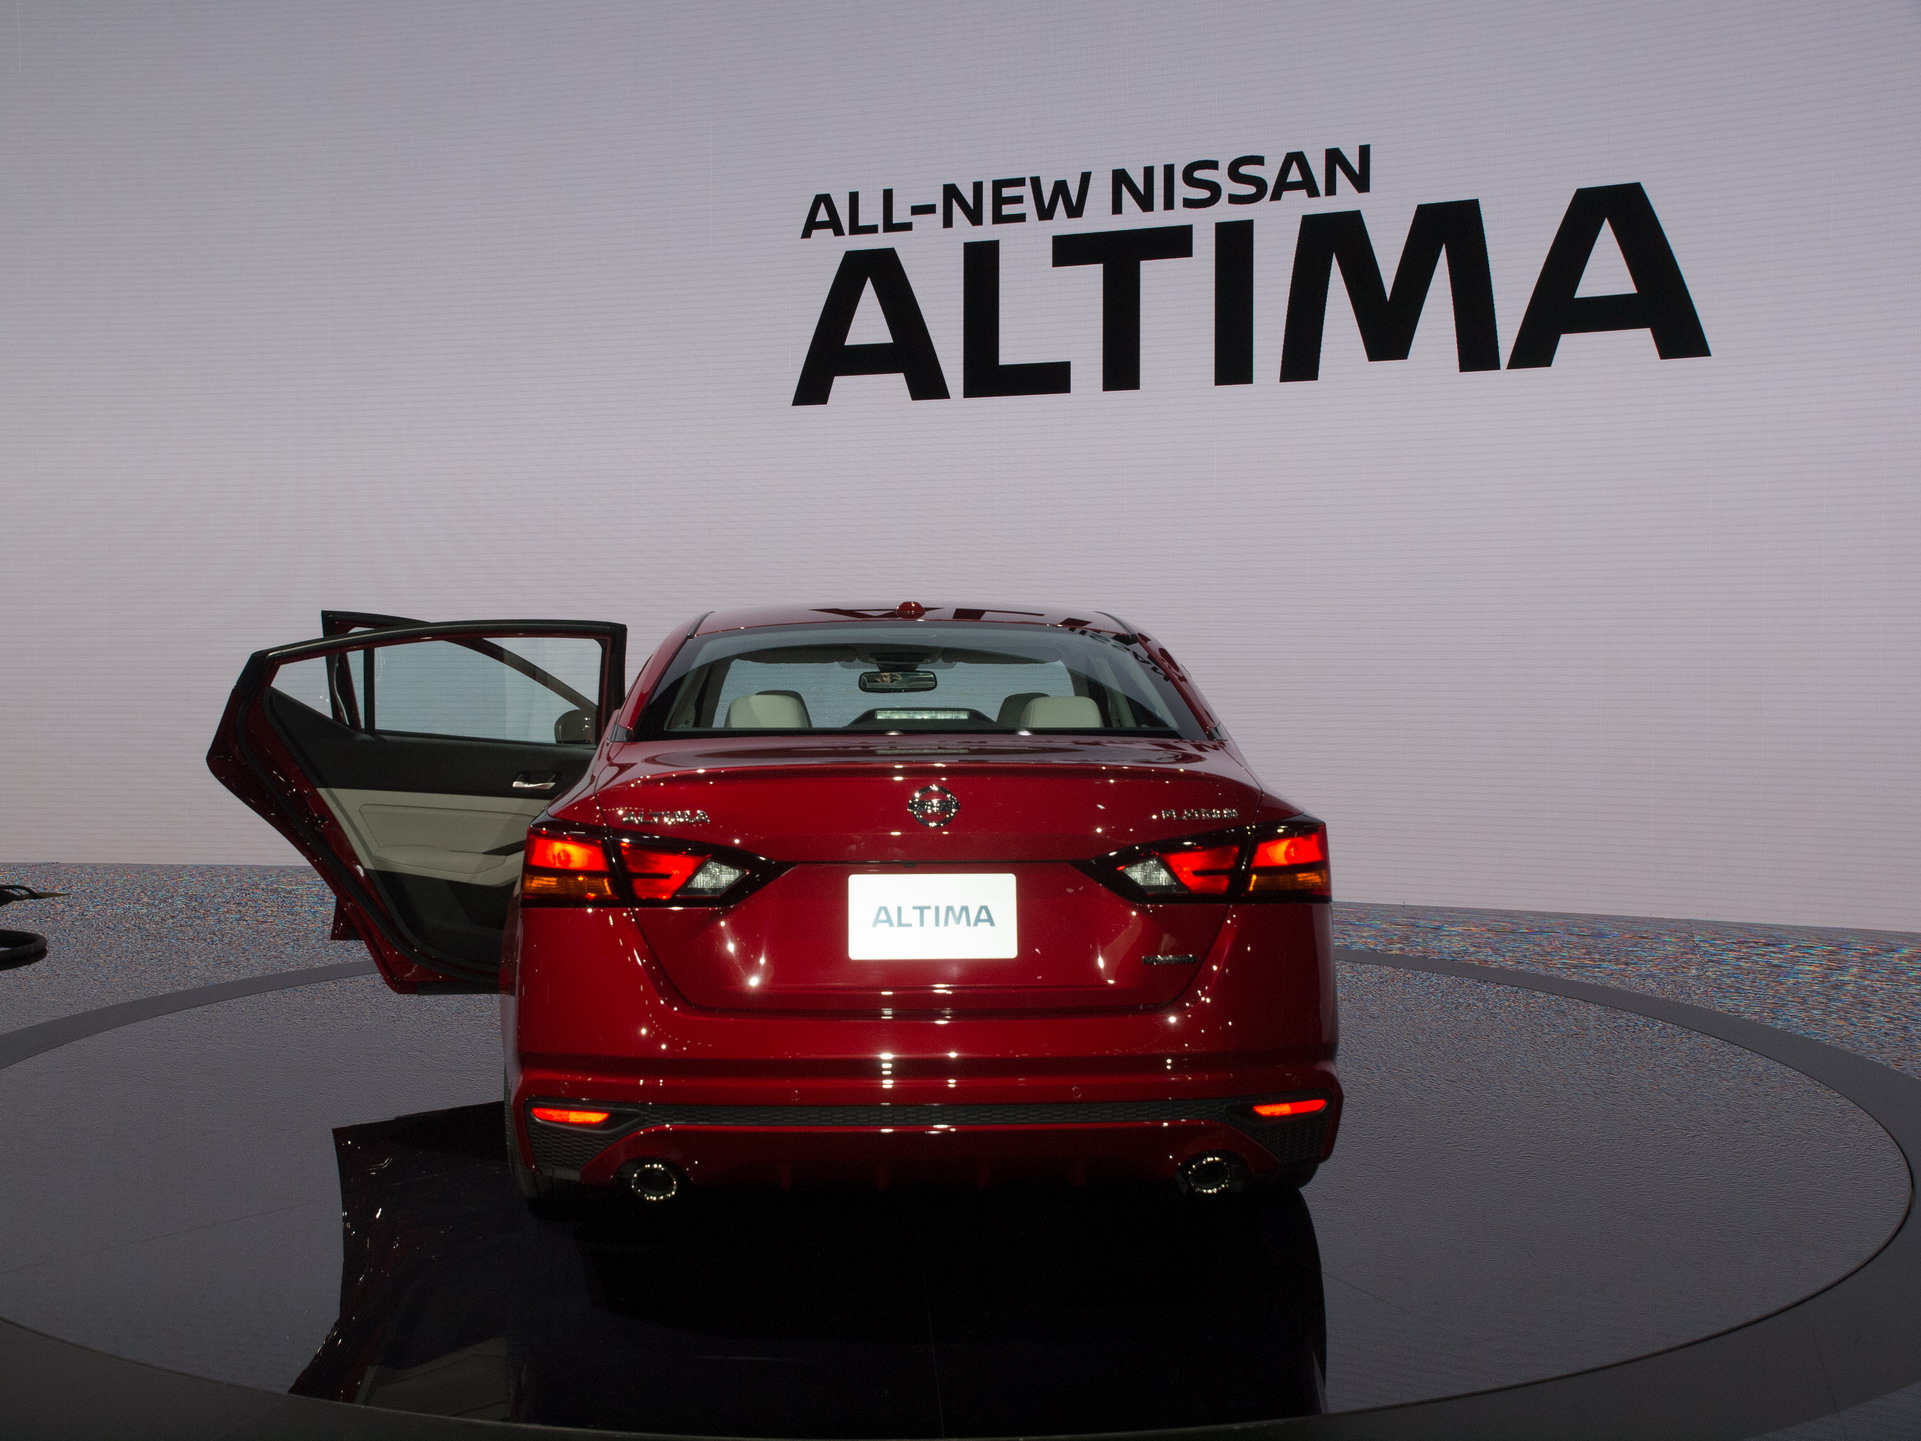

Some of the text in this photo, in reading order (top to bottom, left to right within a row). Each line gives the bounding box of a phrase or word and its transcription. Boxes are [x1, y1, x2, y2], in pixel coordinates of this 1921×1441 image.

[800, 143, 1371, 240] ALL-NEW NISSAN
[791, 181, 1711, 407] ALTIMA
[871, 904, 996, 928] ALTIMA
